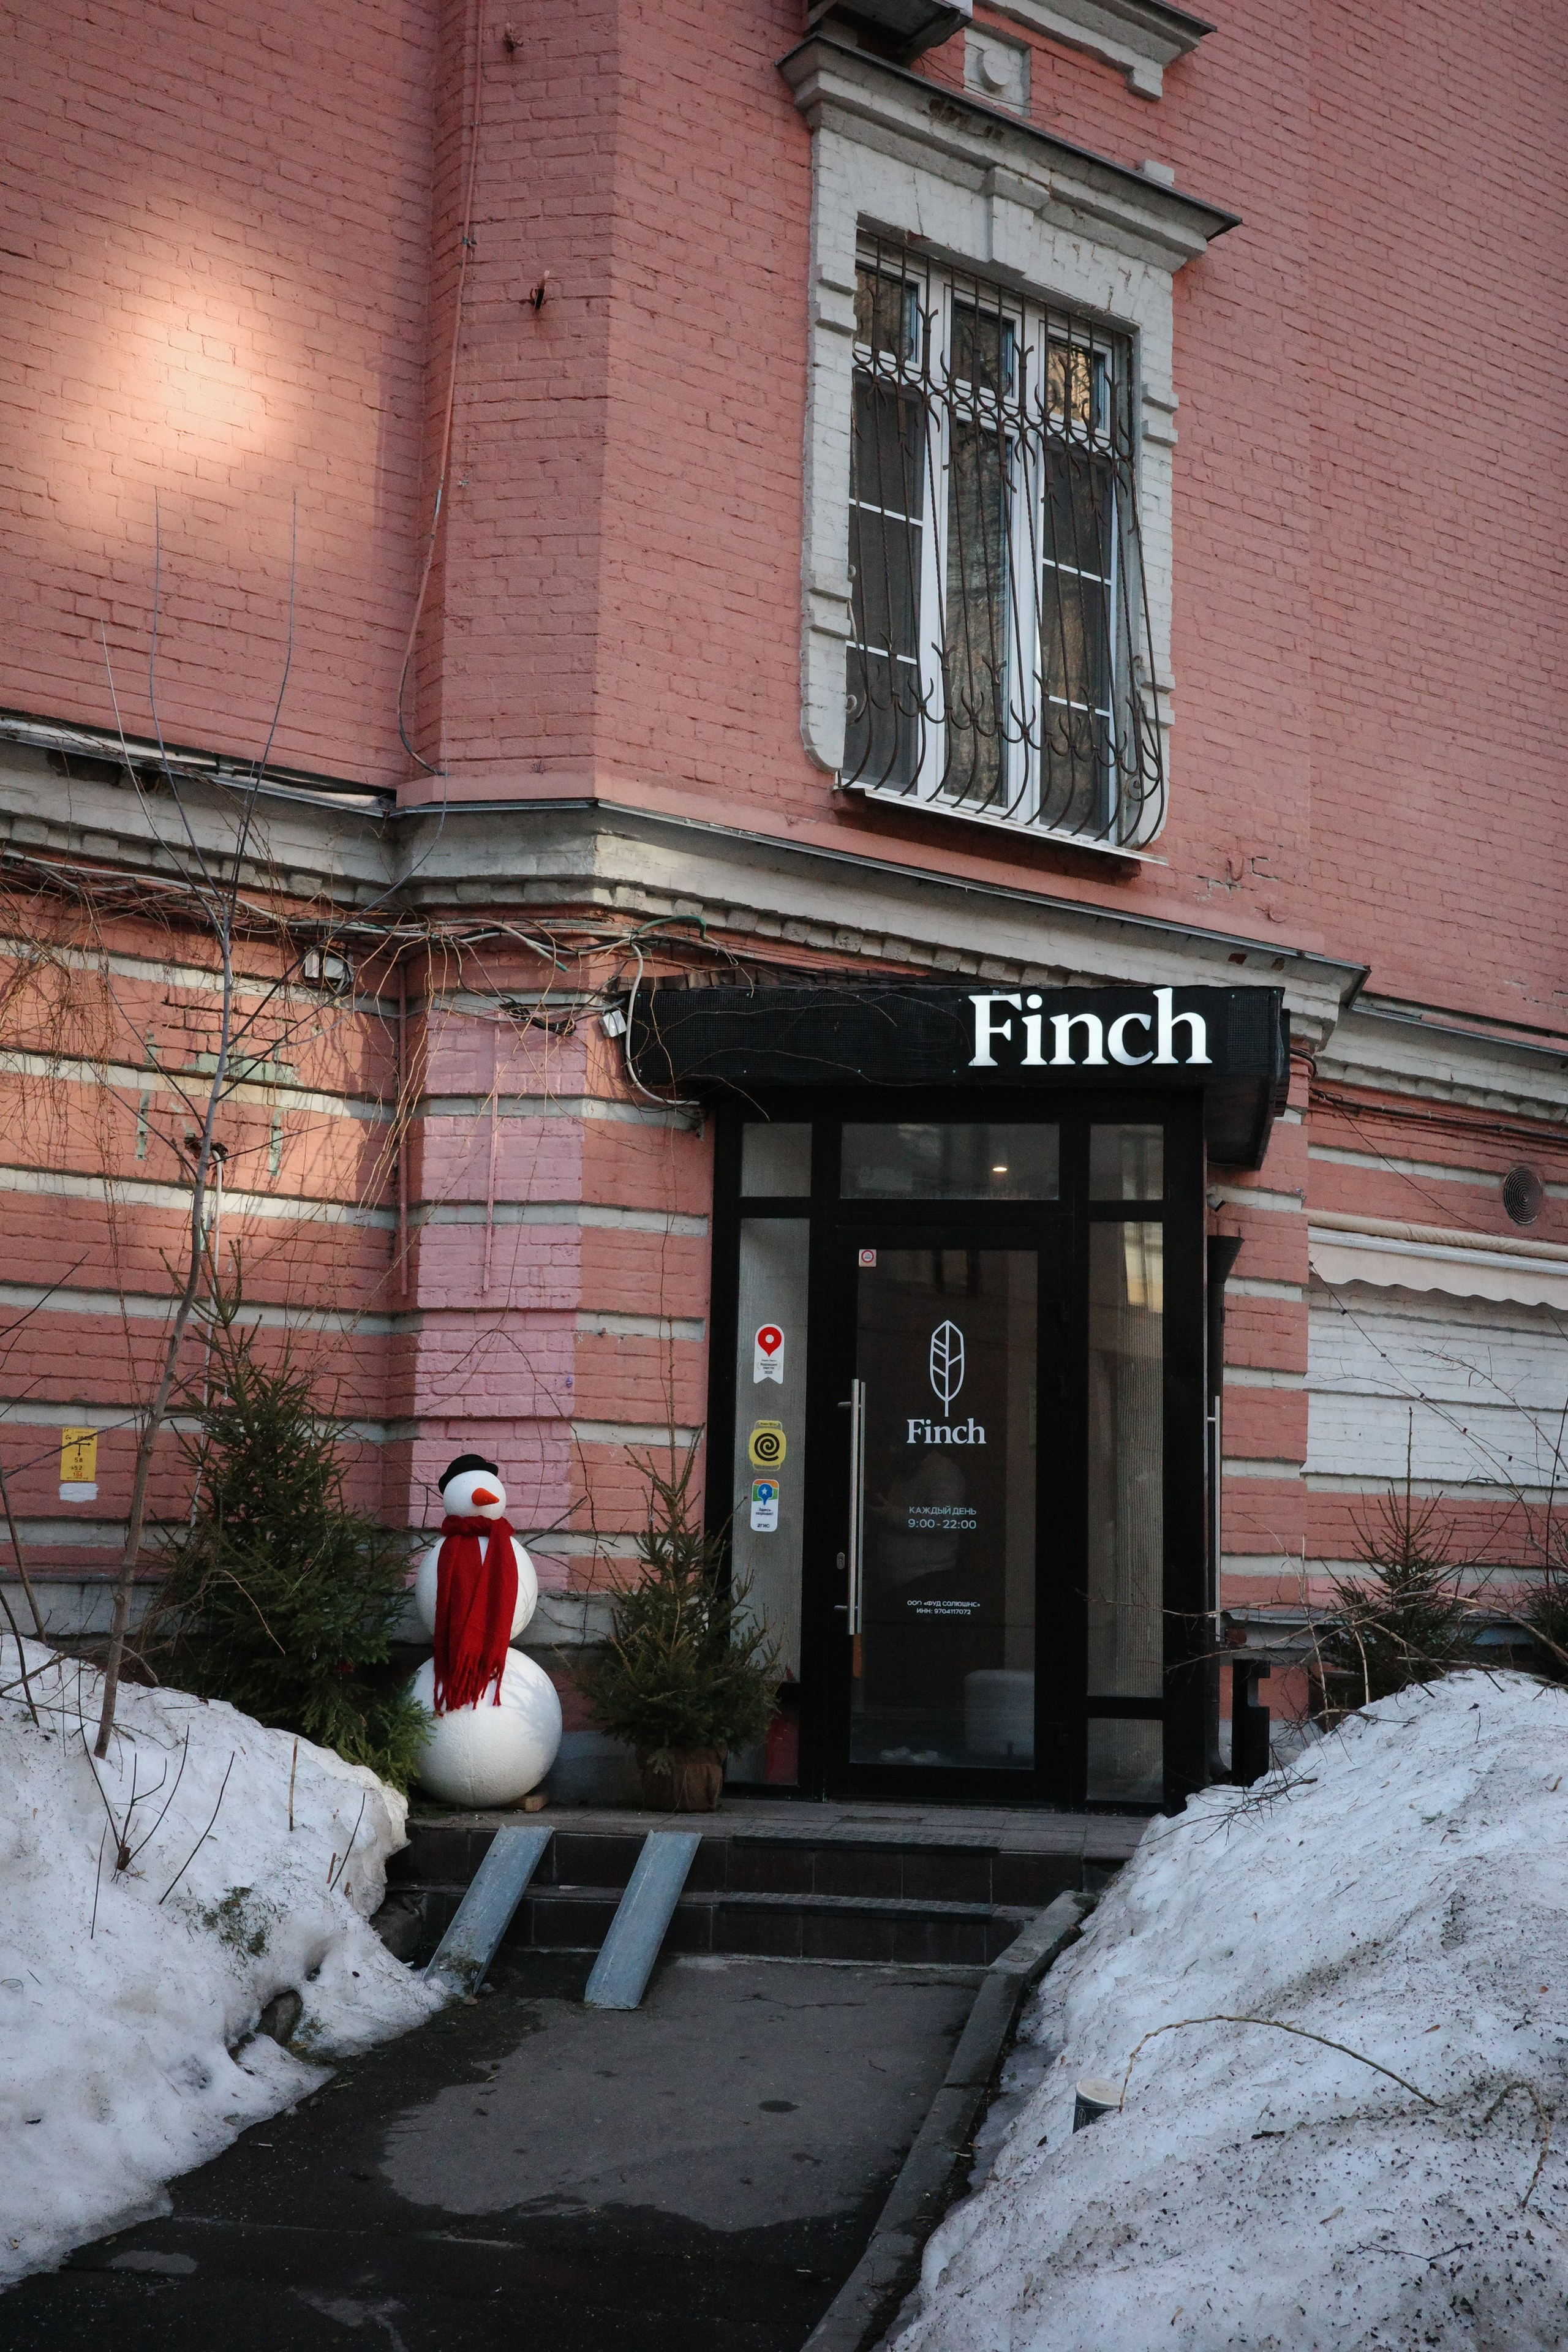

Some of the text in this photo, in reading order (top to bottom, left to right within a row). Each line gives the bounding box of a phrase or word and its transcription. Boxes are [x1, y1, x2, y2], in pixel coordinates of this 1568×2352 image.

[968, 987, 1213, 1066] Finch
[907, 1418, 987, 1444] Finch
[909, 1505, 951, 1515] КАЖДЫЙ
[908, 1518, 935, 1528] 9:00
[943, 1520, 977, 1529] 22:00
